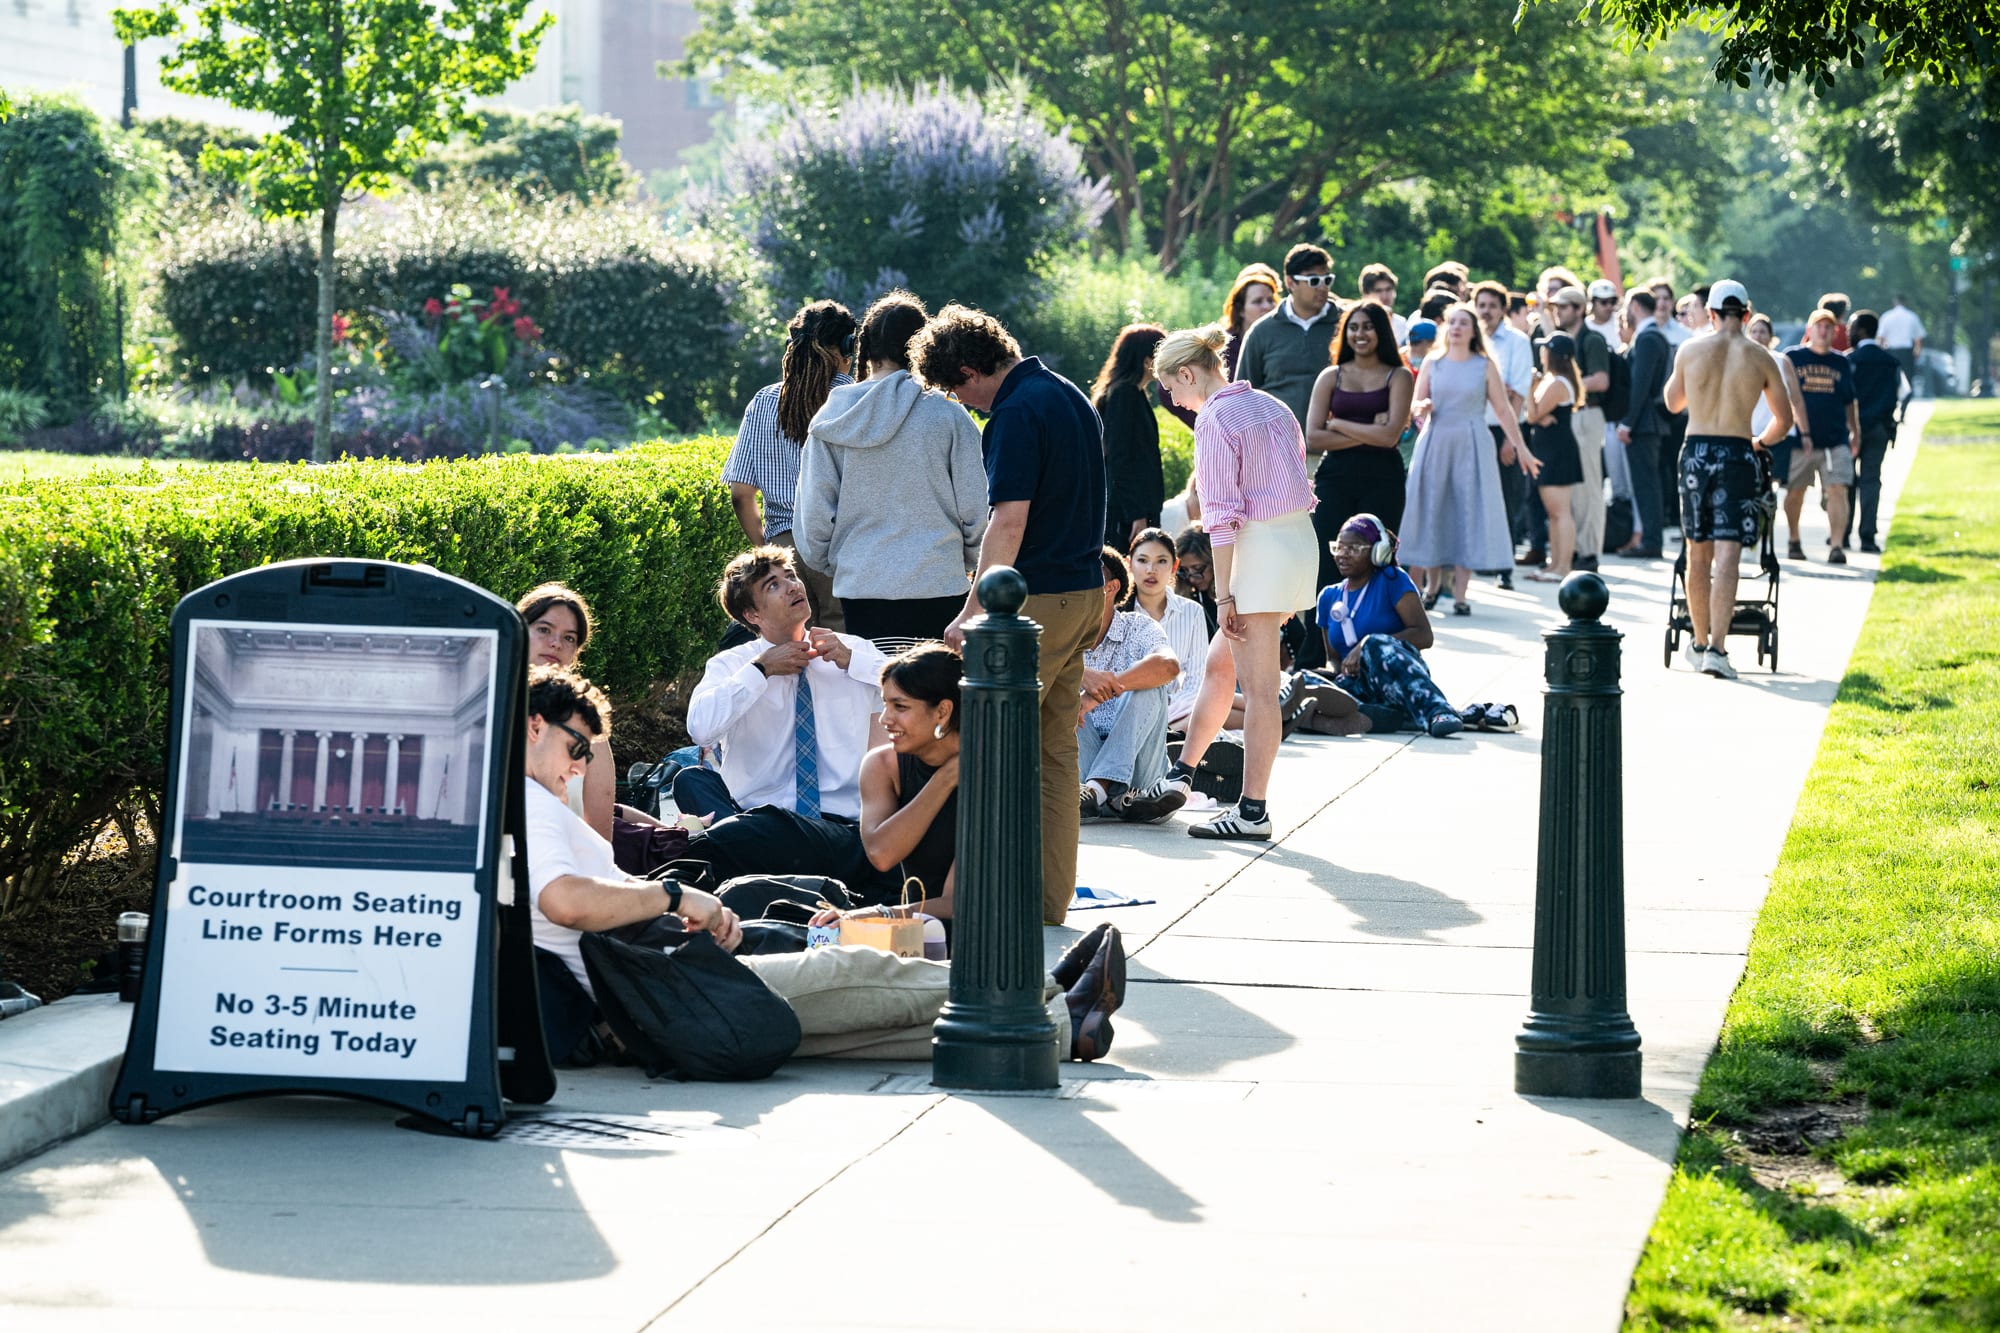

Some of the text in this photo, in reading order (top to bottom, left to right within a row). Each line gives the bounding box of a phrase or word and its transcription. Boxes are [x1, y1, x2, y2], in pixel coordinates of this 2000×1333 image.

[188, 885, 462, 921] Courtroom Seating
[202, 918, 443, 948] Line Forms Here
[811, 934, 830, 943] VITA
[215, 992, 417, 1020] No 3-5 Minute
[209, 1025, 418, 1059] Seating Today
